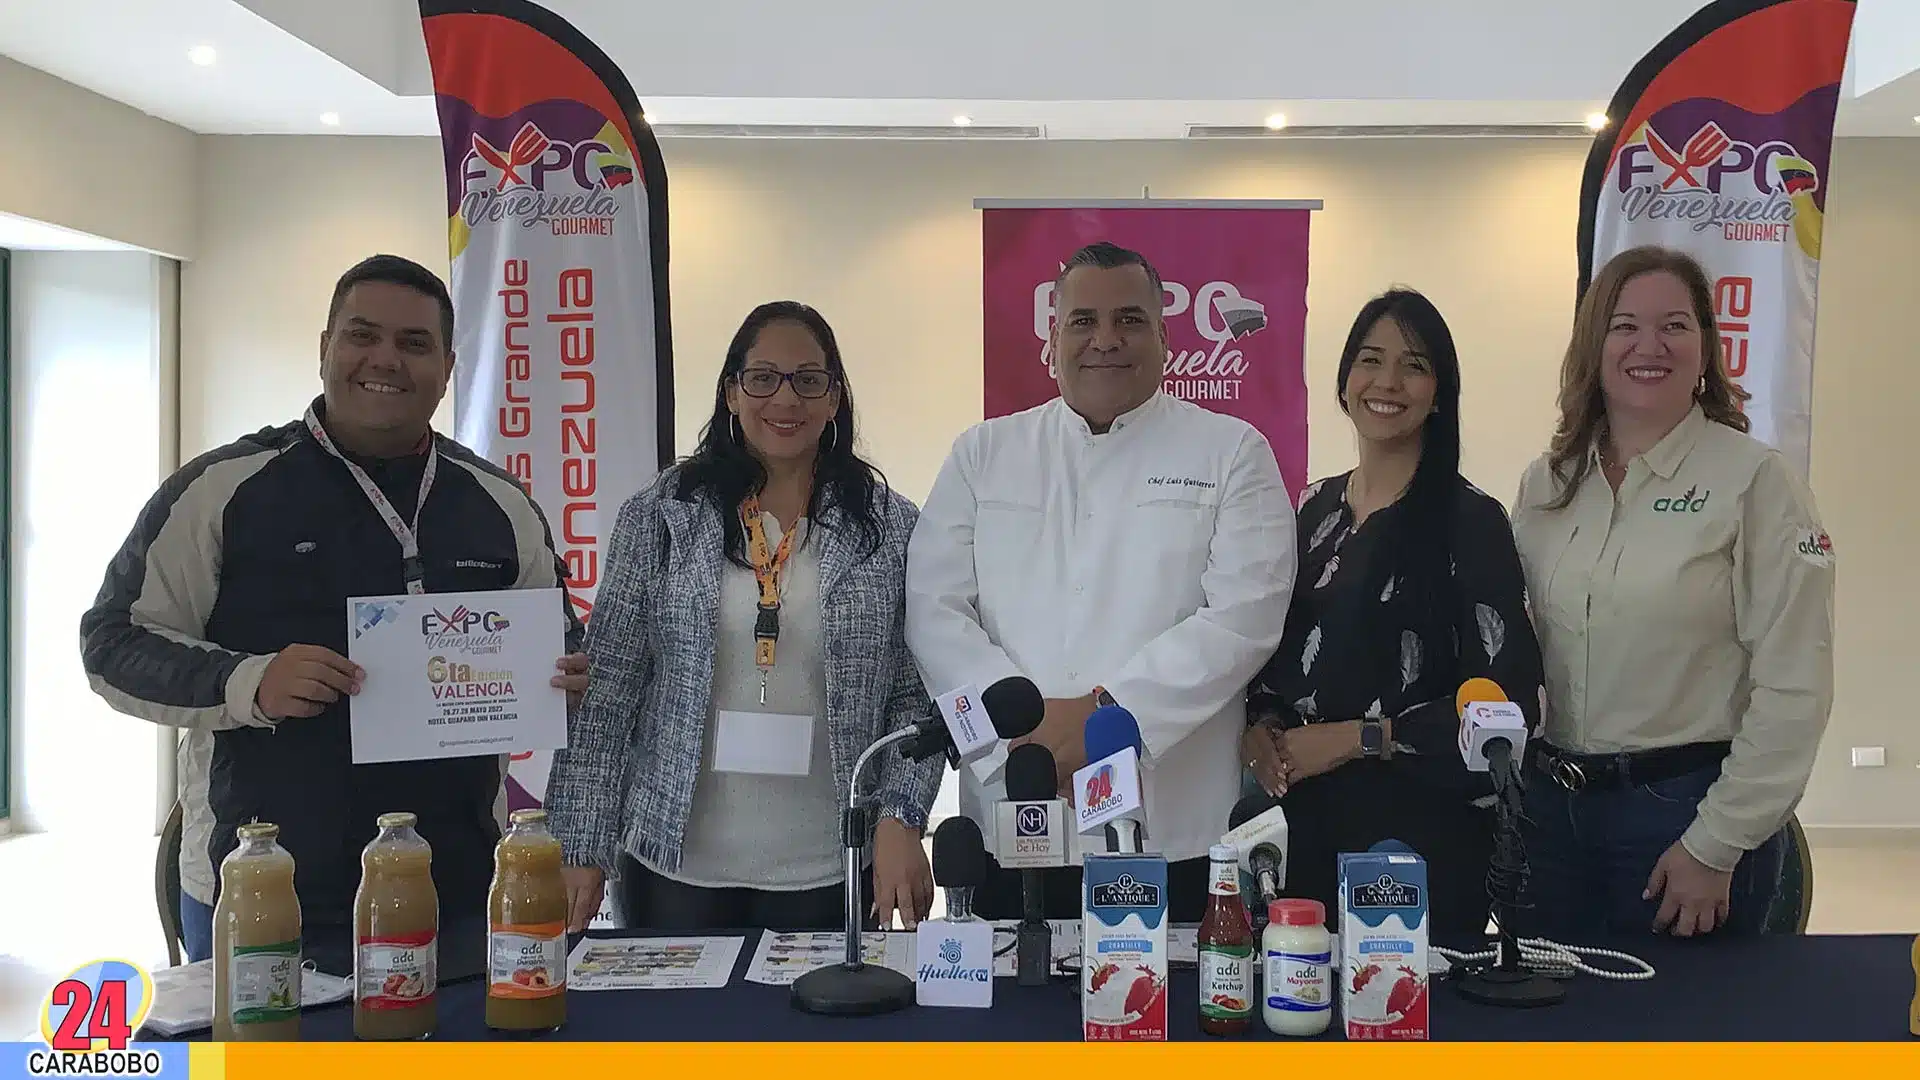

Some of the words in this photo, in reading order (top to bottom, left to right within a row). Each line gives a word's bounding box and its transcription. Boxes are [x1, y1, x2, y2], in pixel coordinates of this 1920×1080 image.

[462, 185, 620, 230] Venezuela
[1621, 186, 1796, 231] Venezuela
[551, 217, 615, 236] GOURMET
[1724, 223, 1790, 241] GOURMET
[498, 259, 532, 438] Grande
[1164, 380, 1242, 400] GOURMET
[1148, 476, 1165, 486] Chef
[1653, 485, 1711, 512] add
[425, 632, 504, 653] Venezuela
[428, 656, 470, 683] 6ta
[432, 681, 514, 699] VALENCIA
[489, 713, 518, 721] VALENCIA
[1086, 770, 1113, 807] 24
[1081, 794, 1123, 819] CARABOBO
[1022, 812, 1042, 828] NH
[392, 950, 414, 964] add
[521, 943, 542, 955] add
[917, 964, 974, 983] Huellas
[1217, 962, 1240, 976] add
[1296, 966, 1317, 979] add
[1212, 982, 1244, 992] Ketchup
